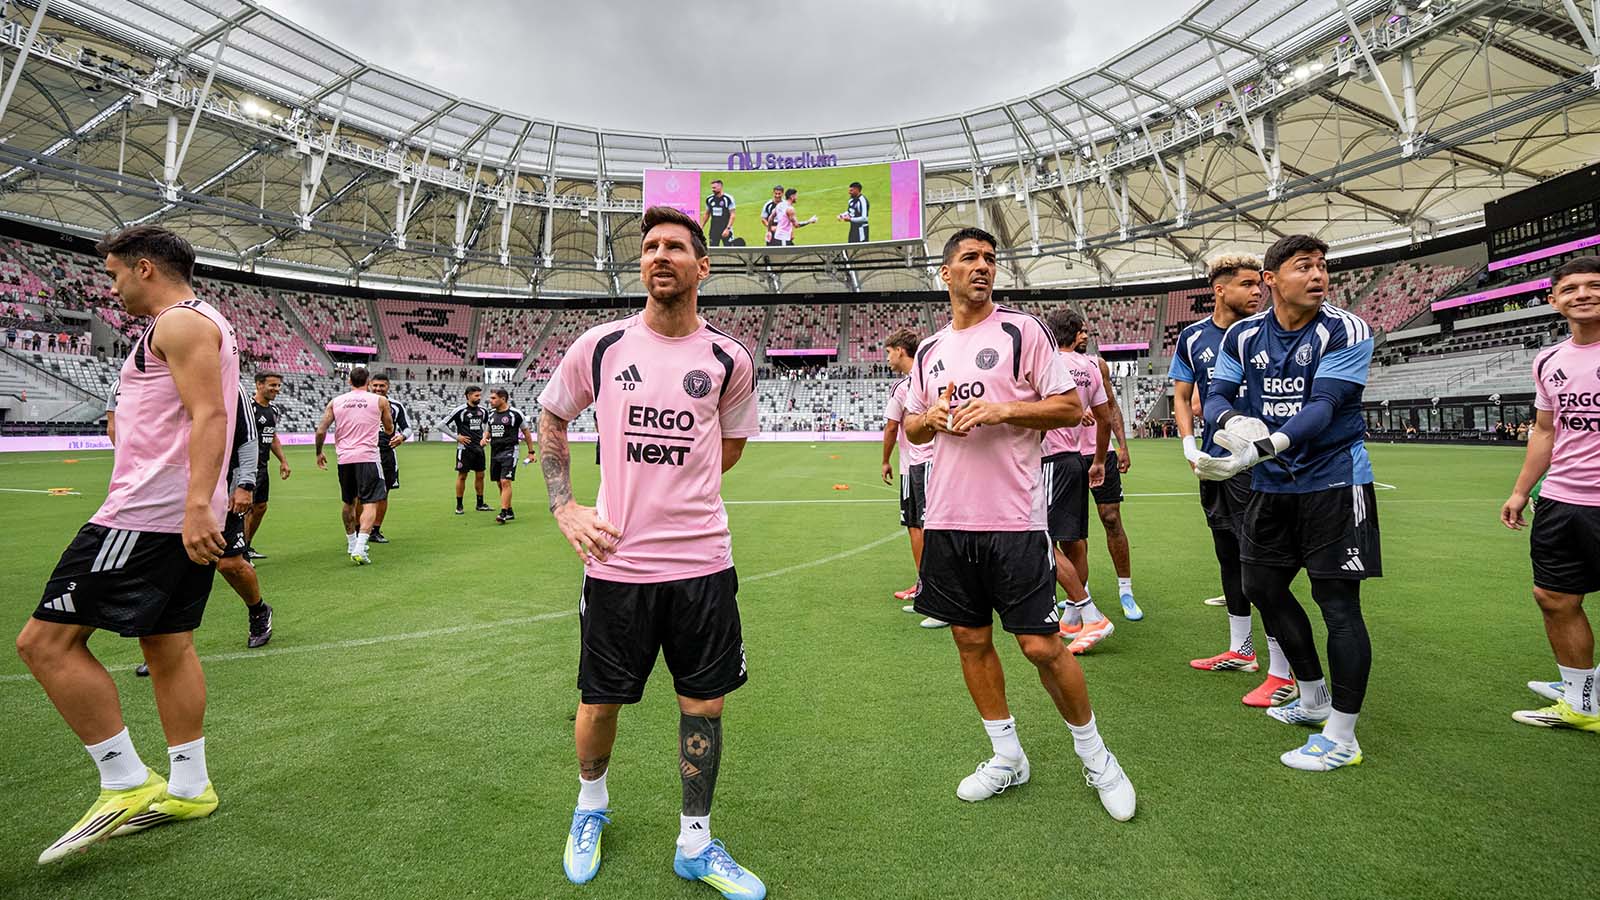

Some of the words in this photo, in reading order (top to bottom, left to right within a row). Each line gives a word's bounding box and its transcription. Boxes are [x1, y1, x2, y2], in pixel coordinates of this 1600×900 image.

[765, 152, 837, 170] Stadium
[622, 382, 636, 391] 10
[1263, 376, 1305, 393] ERGO
[628, 405, 695, 432] ERGO
[1346, 547, 1360, 556] 13
[66, 581, 77, 591] 3
